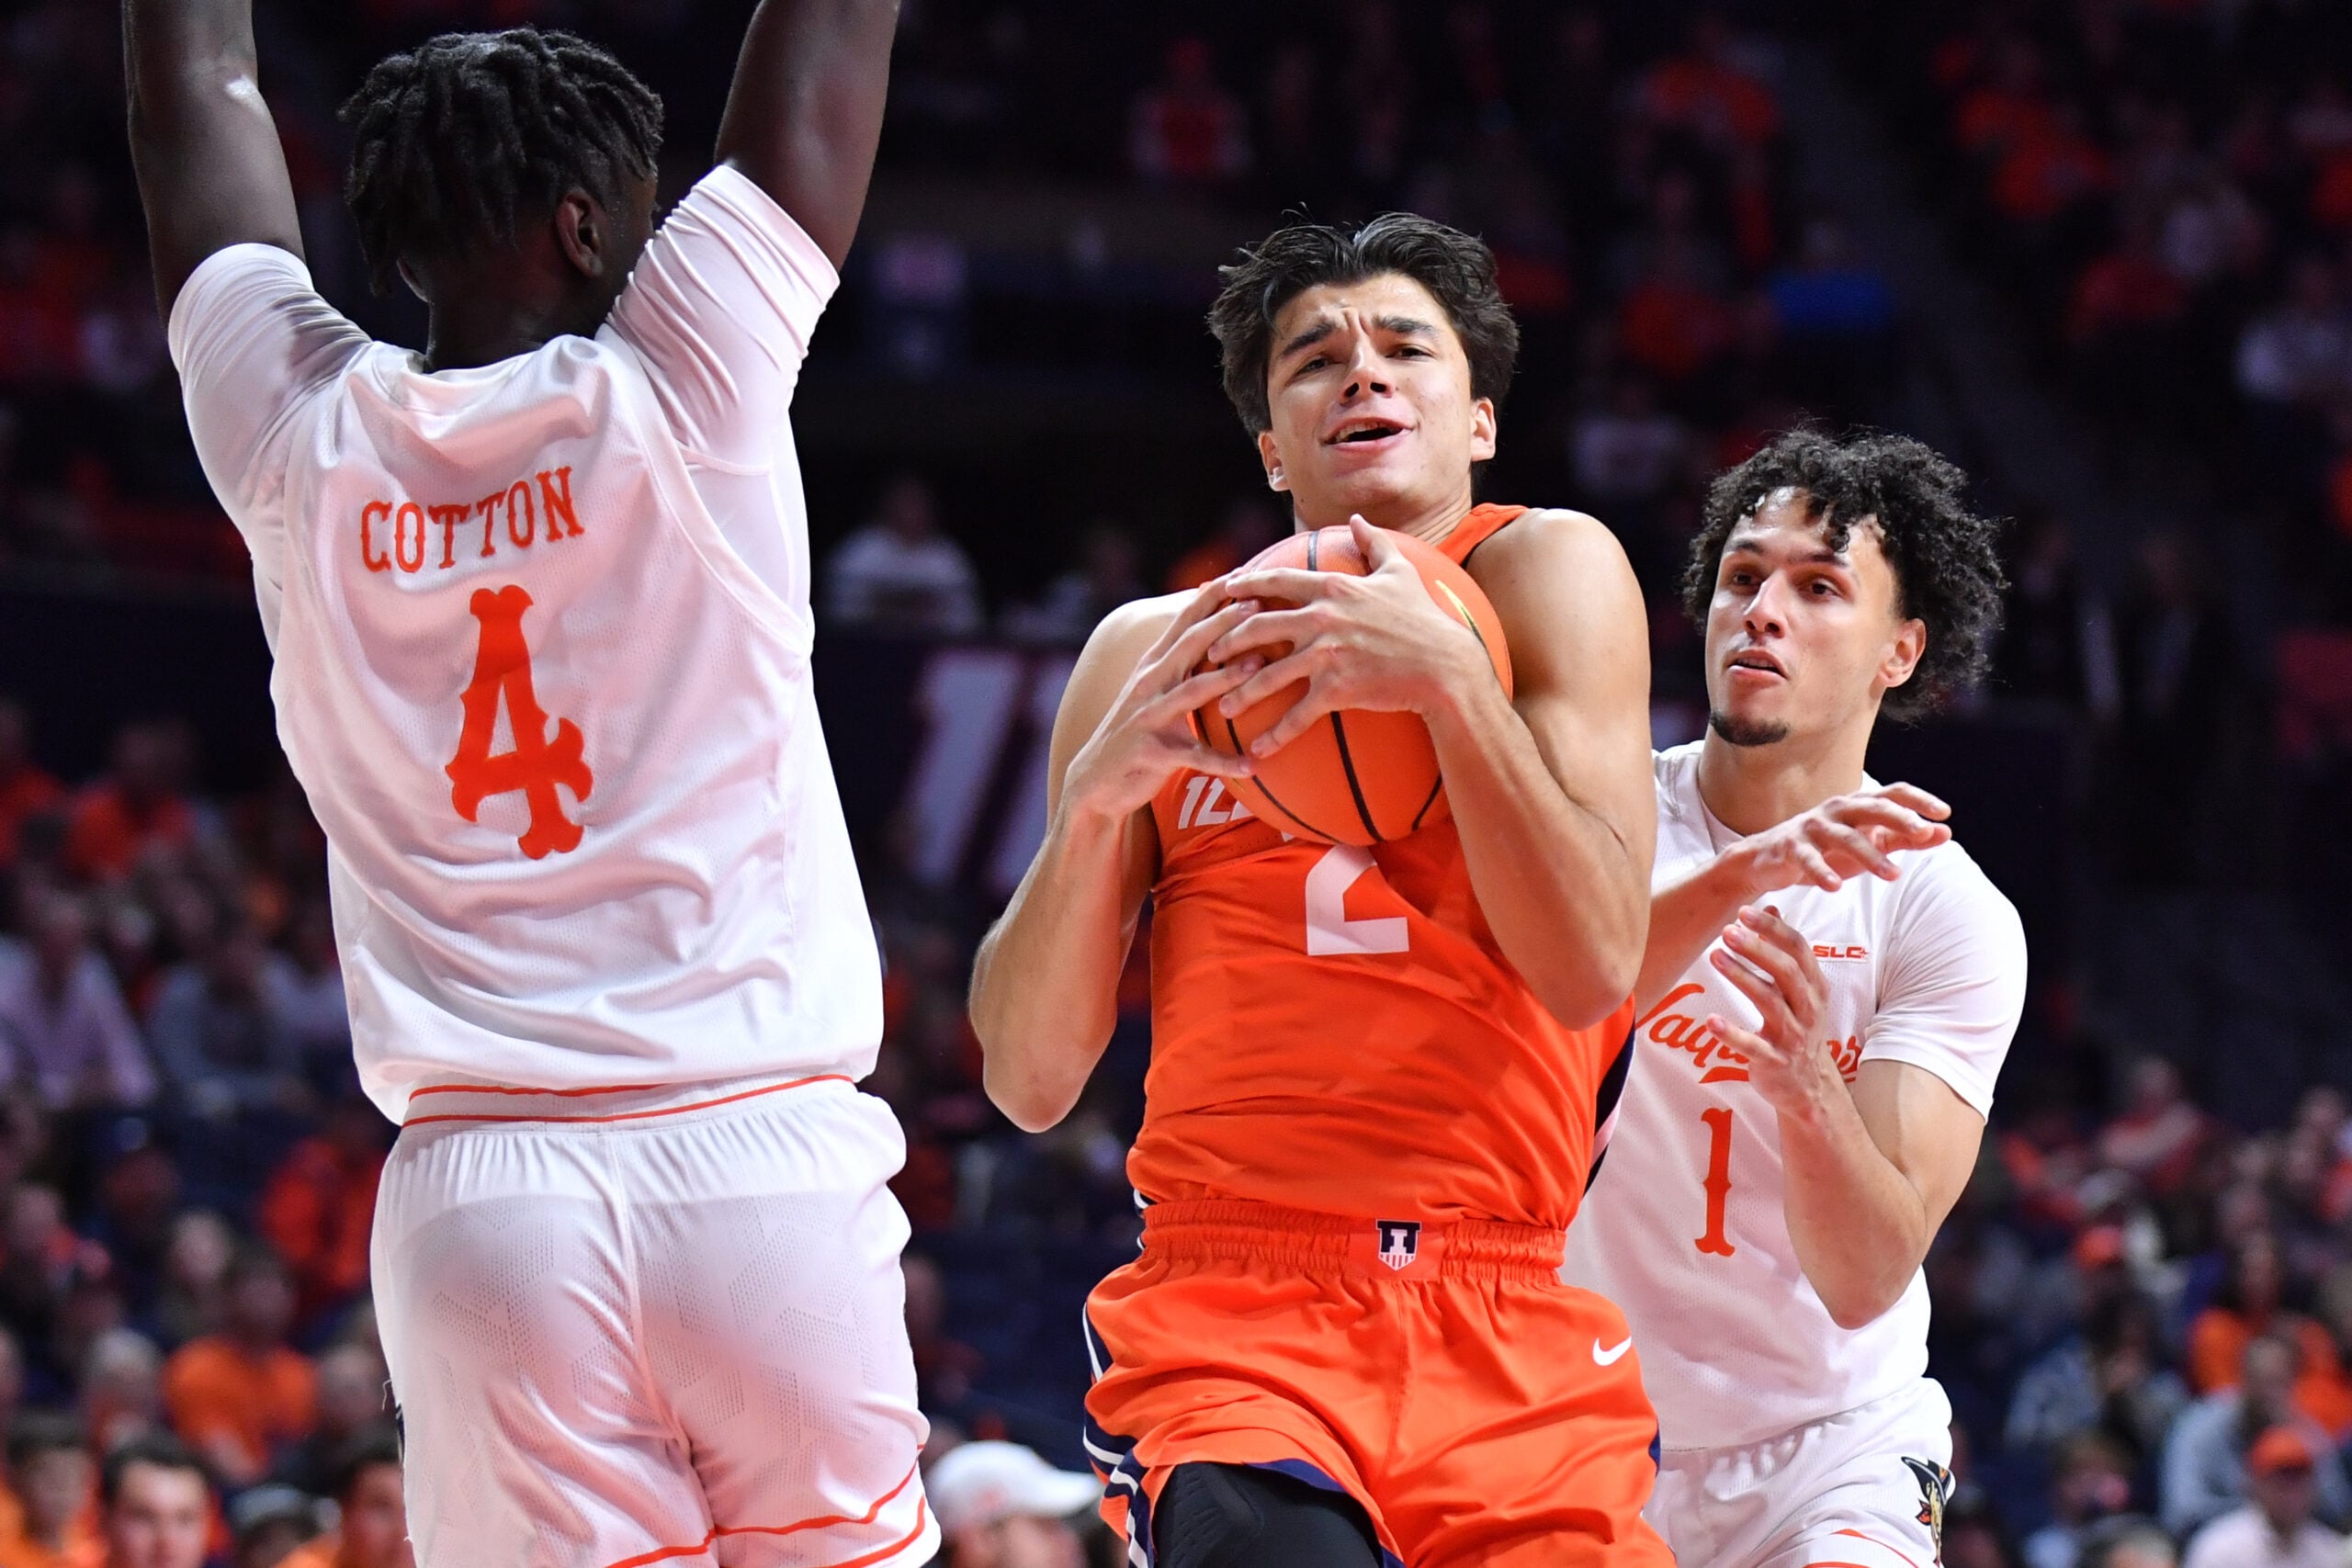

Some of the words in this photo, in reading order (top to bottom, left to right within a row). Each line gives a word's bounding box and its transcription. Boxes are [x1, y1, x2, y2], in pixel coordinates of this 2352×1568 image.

[360, 466, 585, 573] COTTON
[445, 584, 594, 860] 4
[1694, 1108, 1736, 1258] 1
